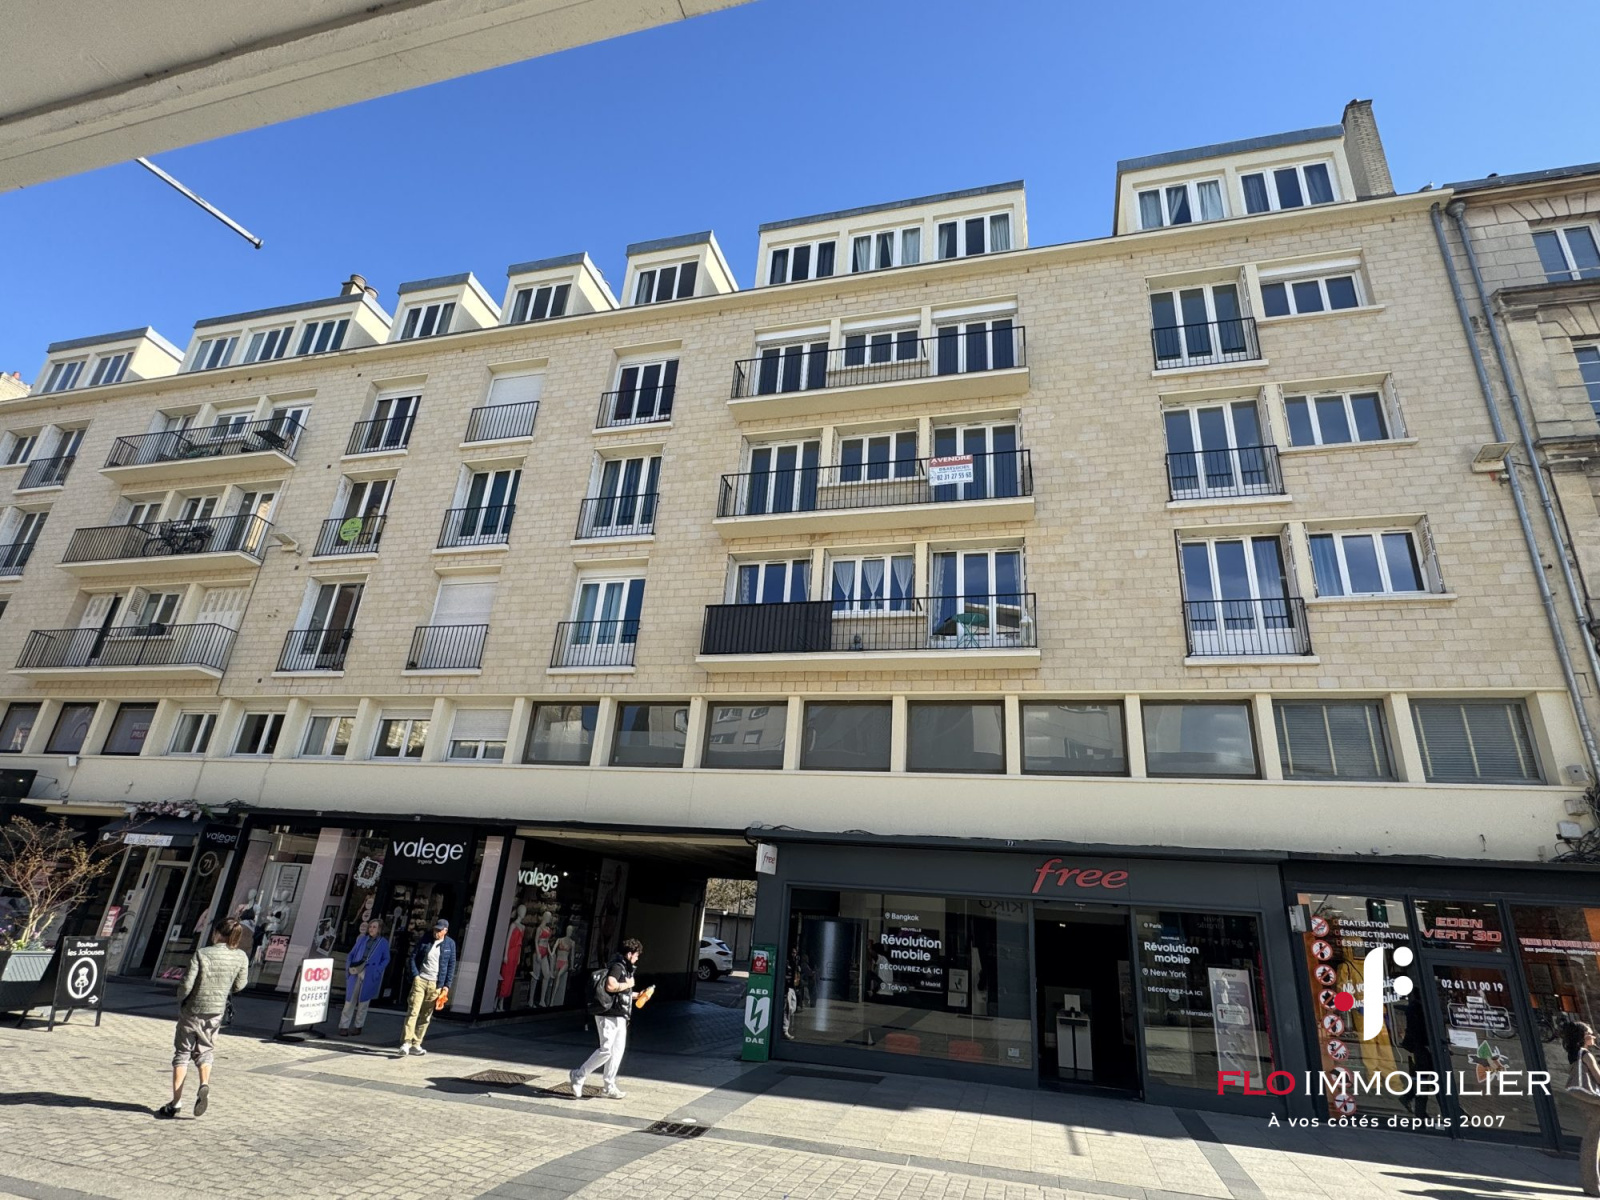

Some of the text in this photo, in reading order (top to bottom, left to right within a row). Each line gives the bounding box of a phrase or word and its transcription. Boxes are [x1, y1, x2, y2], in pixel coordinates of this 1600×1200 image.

[951, 472, 957, 480] 27
[958, 471, 965, 479] 55
[206, 831, 238, 844] valege
[393, 837, 464, 864] valege
[763, 852, 776, 866] free
[518, 867, 559, 892] valege
[1032, 858, 1129, 893] free
[891, 912, 920, 922] Bangkok
[1435, 917, 1483, 928] EDEN
[881, 933, 942, 949] Révolution
[1422, 929, 1502, 942] VERT 3D
[67, 948, 105, 956] les Jalouses
[1144, 941, 1200, 954] Révolution
[891, 949, 931, 961] mobile
[1154, 954, 1191, 965] mobile
[933, 967, 943, 975] ICI
[1150, 969, 1187, 978] New York
[888, 983, 908, 993] Tokyo
[1441, 979, 1504, 992] 02 61 11 00 19
[300, 992, 328, 1002] OFFERT
[745, 1036, 765, 1044] DAE
